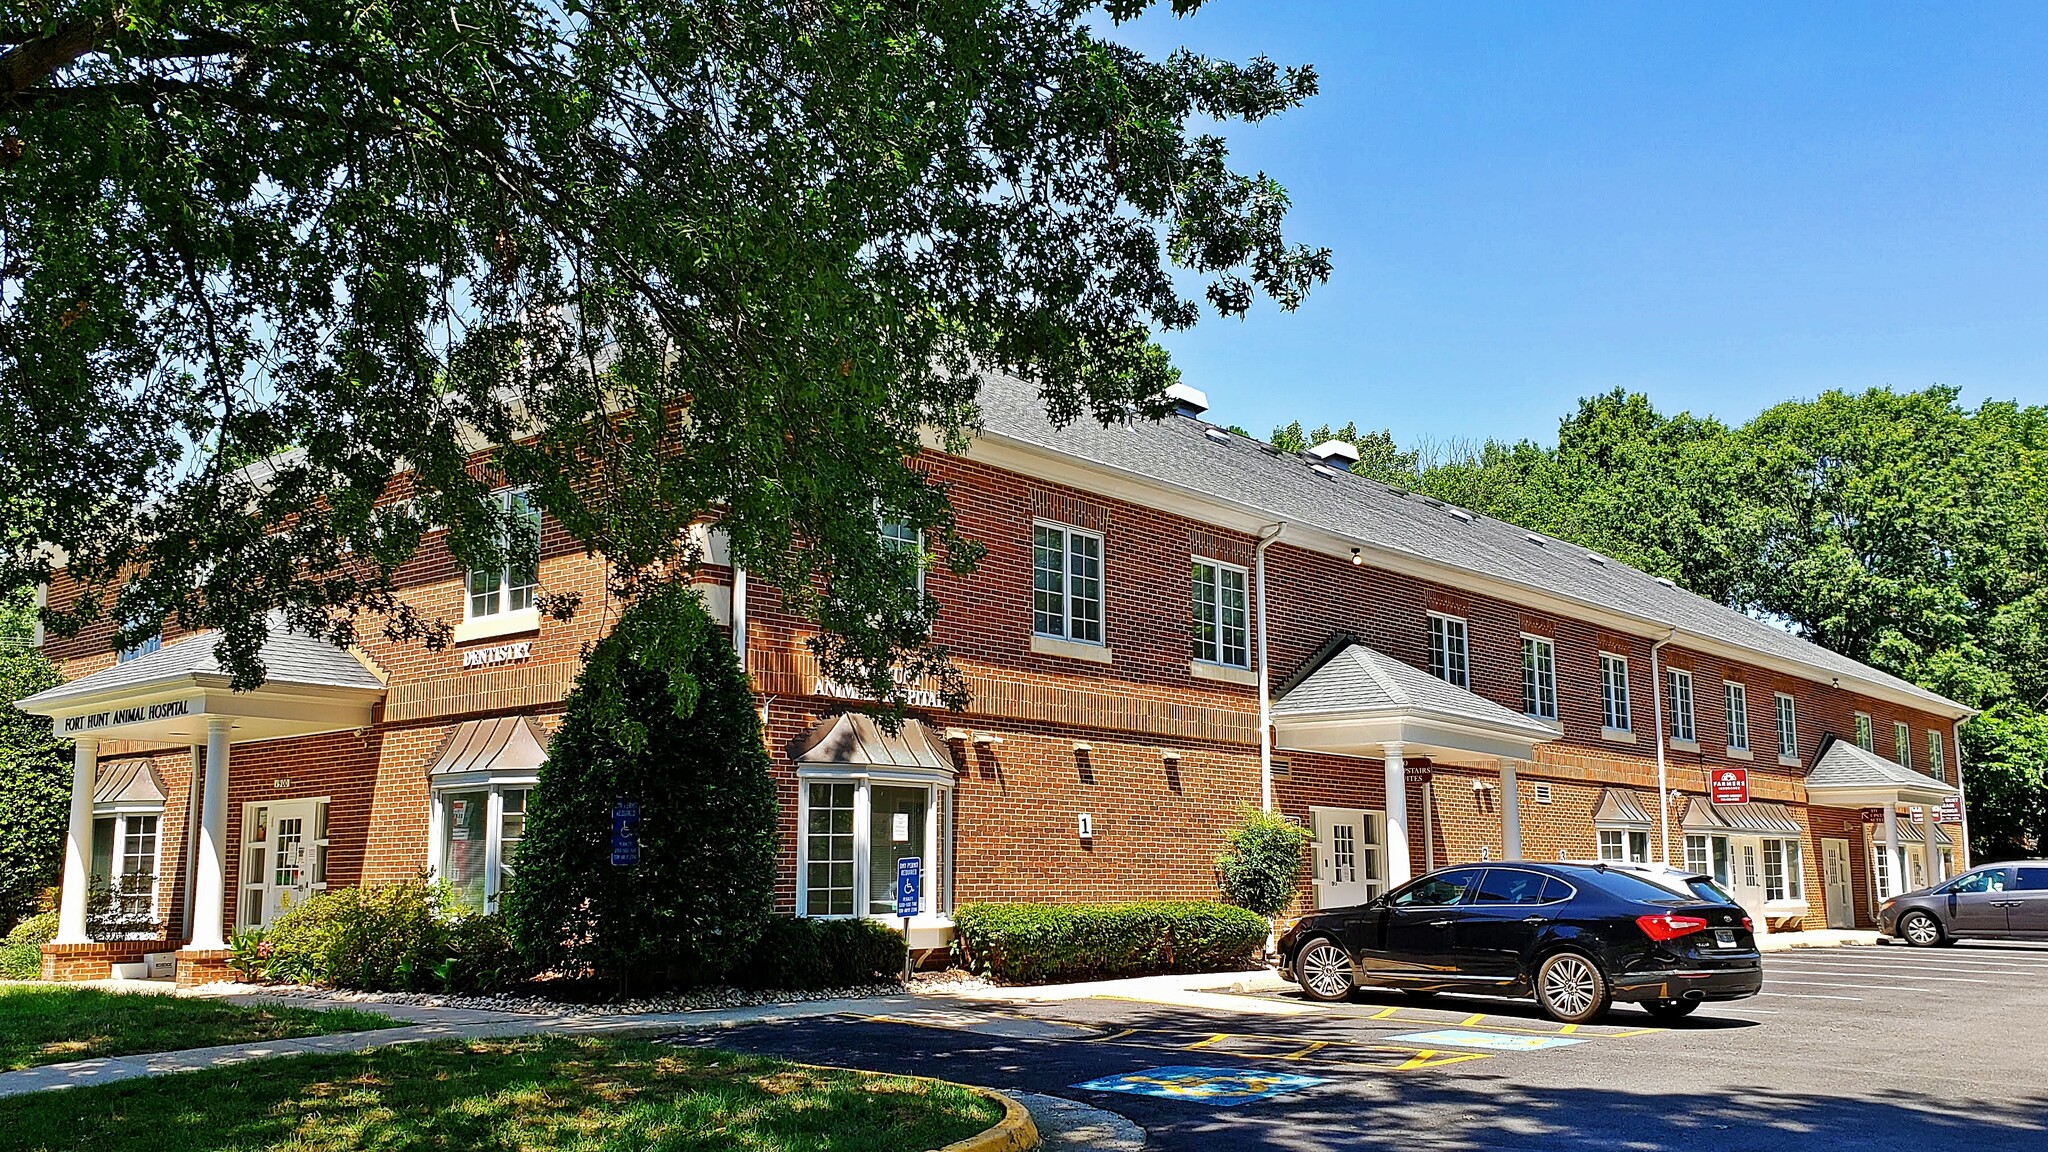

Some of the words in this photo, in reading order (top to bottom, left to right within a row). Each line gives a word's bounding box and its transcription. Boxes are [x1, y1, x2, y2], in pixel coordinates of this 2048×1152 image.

[463, 641, 532, 667] DENTISTRY
[65, 716, 85, 731] FORT
[87, 712, 111, 729] HUNT
[113, 707, 146, 725] ANIMAL
[148, 700, 189, 719] HOSPITAL
[1081, 817, 1090, 834] 1
[1482, 848, 1488, 860] 2
[1560, 851, 1566, 861] 3
